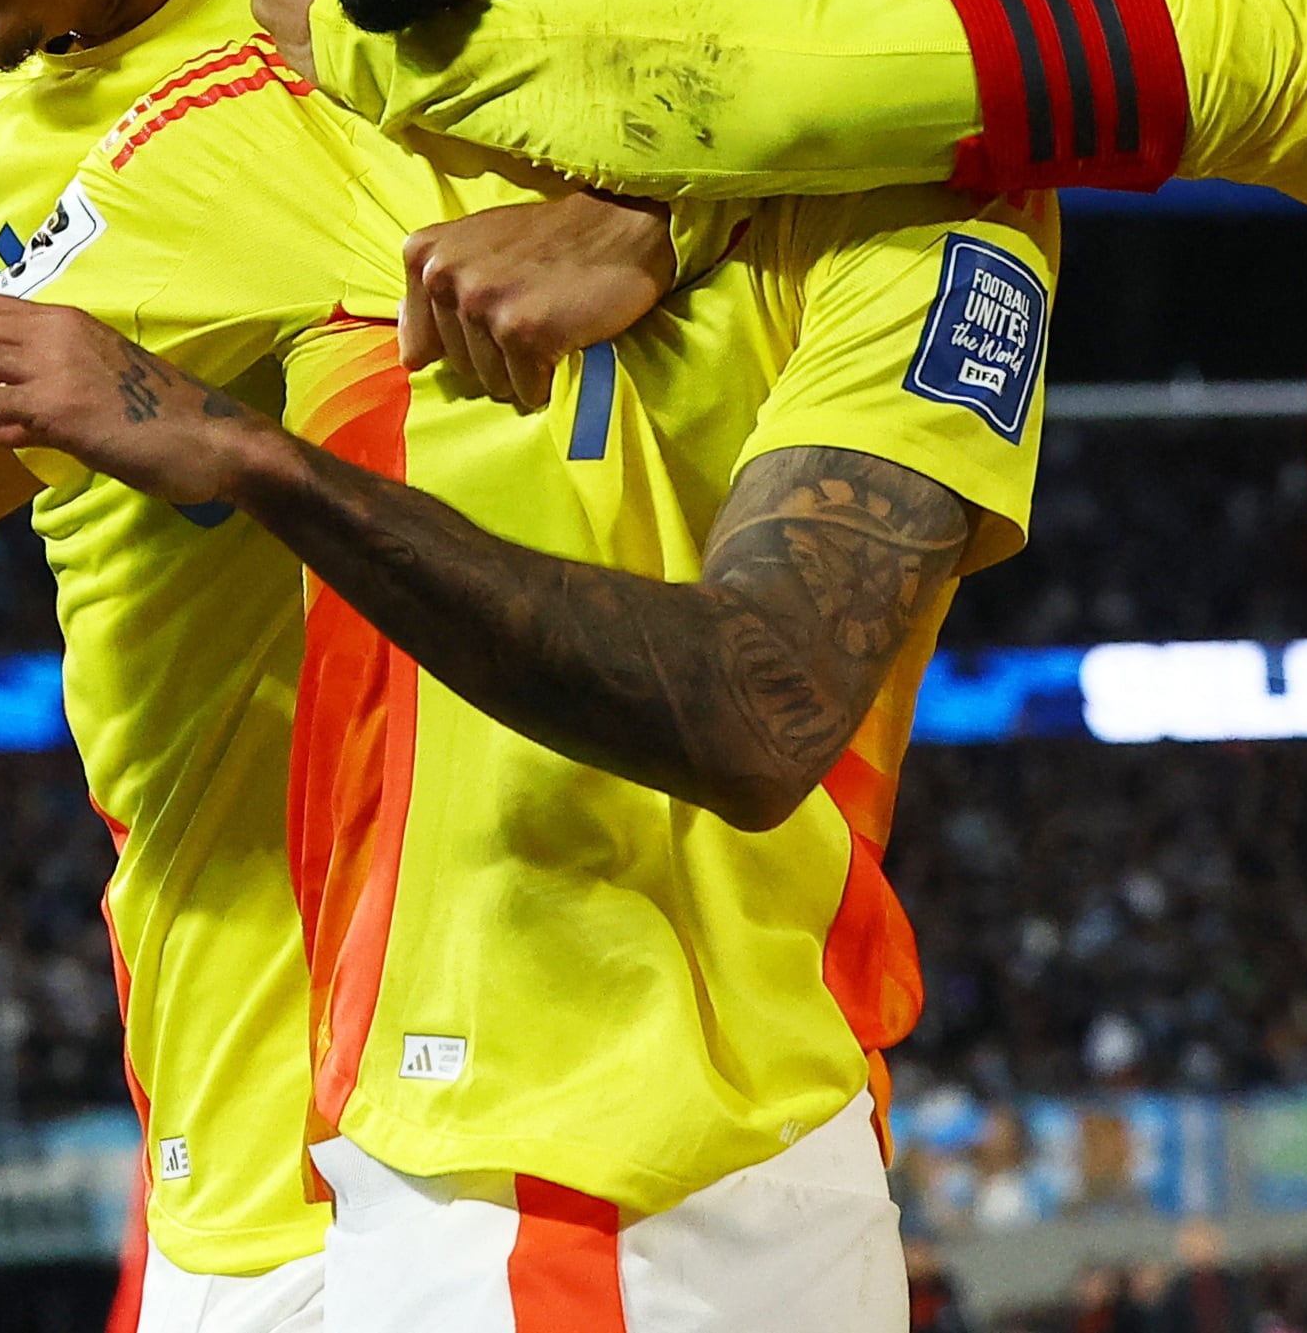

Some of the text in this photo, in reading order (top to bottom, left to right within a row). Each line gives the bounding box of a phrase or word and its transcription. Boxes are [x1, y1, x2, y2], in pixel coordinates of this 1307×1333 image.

[964, 290, 1029, 349] UNITES
[973, 269, 1030, 320] FOOTBALL
[951, 322, 1026, 379] the World
[965, 366, 1000, 387] FIFA
